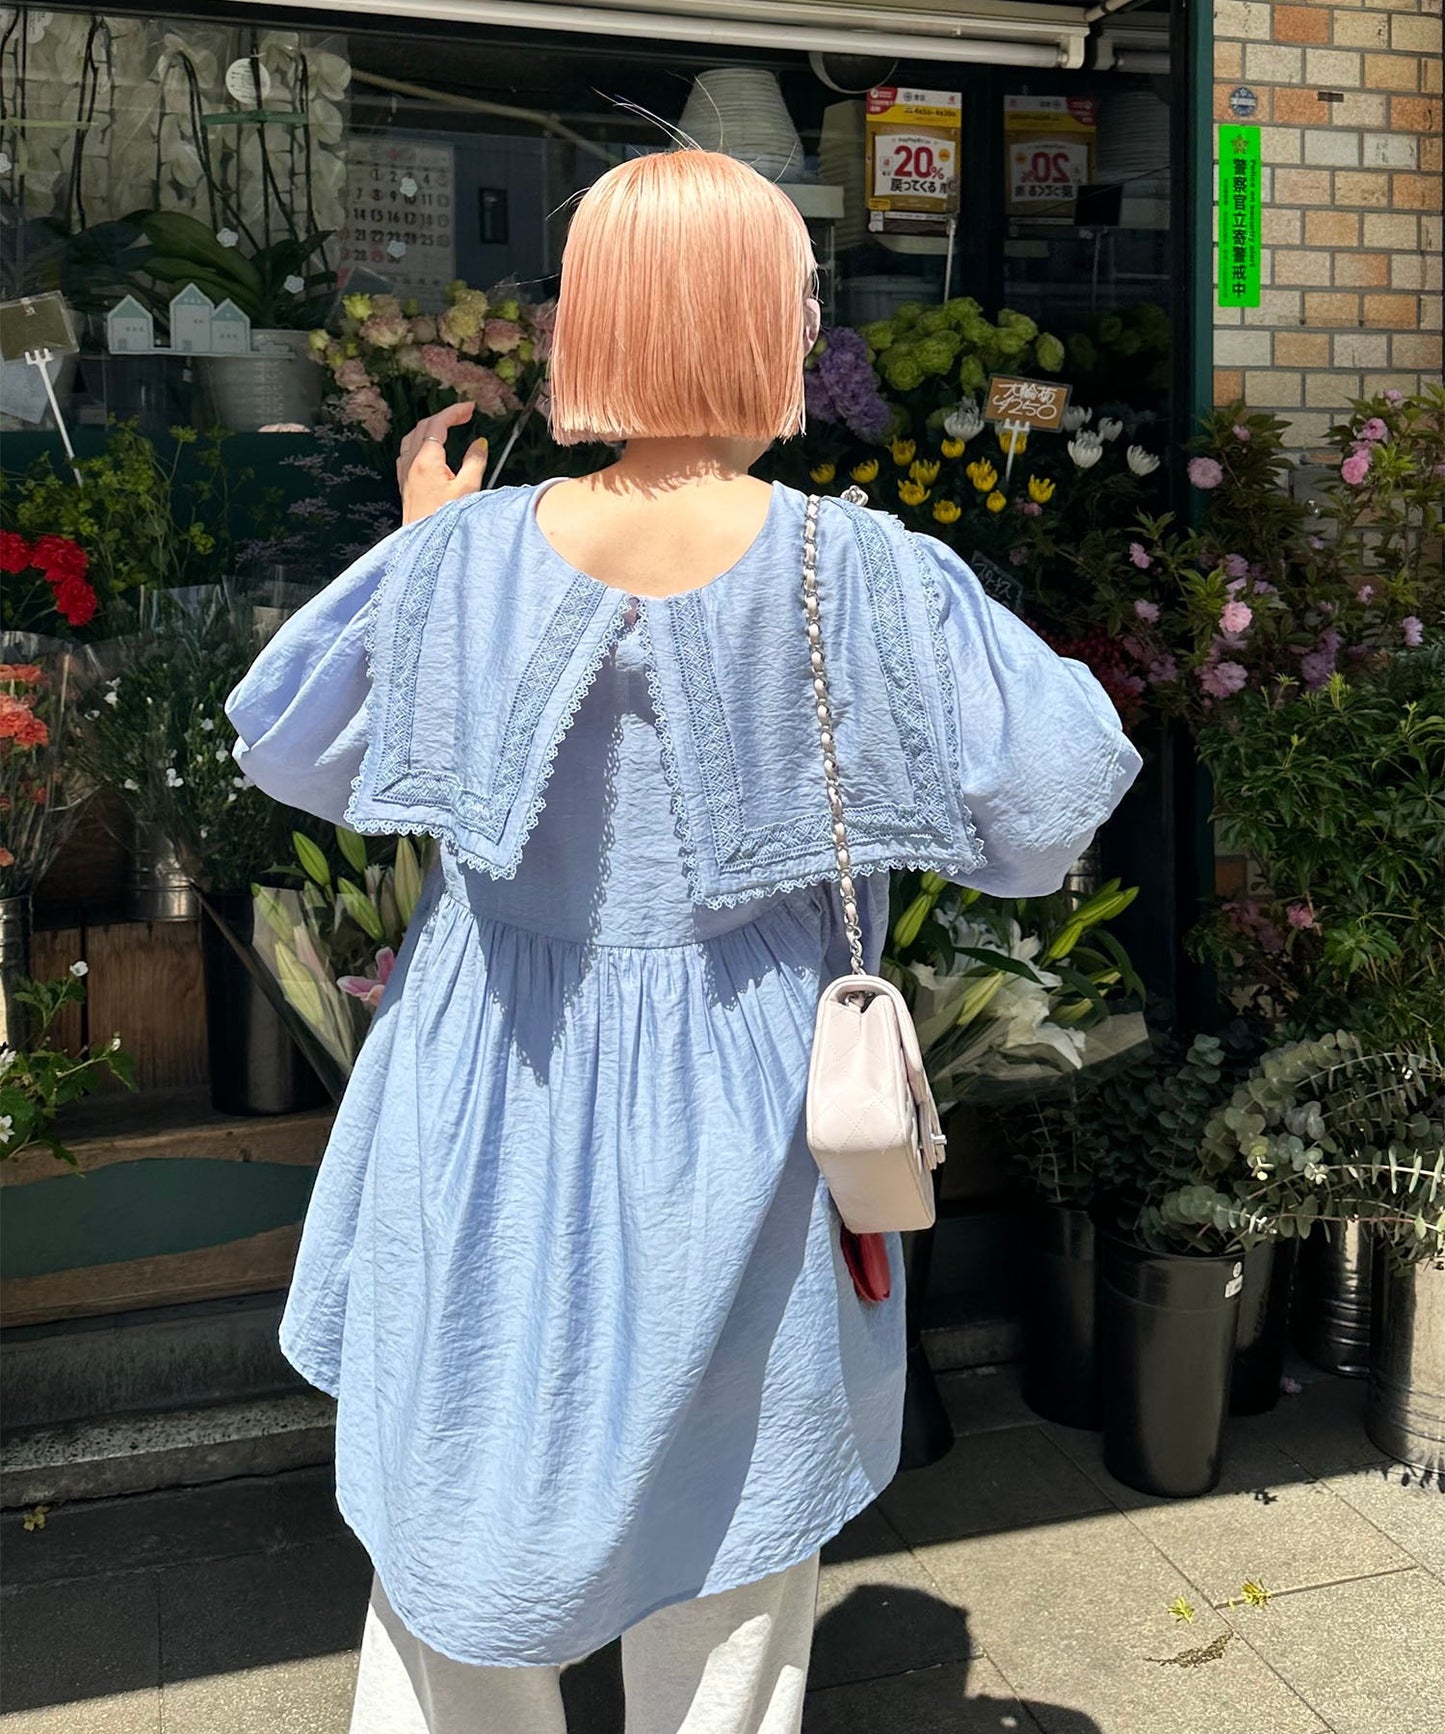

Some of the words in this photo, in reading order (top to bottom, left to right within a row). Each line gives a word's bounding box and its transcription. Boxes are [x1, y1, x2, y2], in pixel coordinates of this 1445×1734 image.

[894, 145, 945, 180] 20%
[890, 178, 936, 193] 戻ってくる
[353, 209, 365, 221] 14
[371, 210, 383, 222] 15
[387, 211, 399, 223] 16
[354, 229, 366, 241] 21
[1232, 158, 1247, 298] 警察官立寄警戒中
[992, 395, 1057, 420] ¥250
